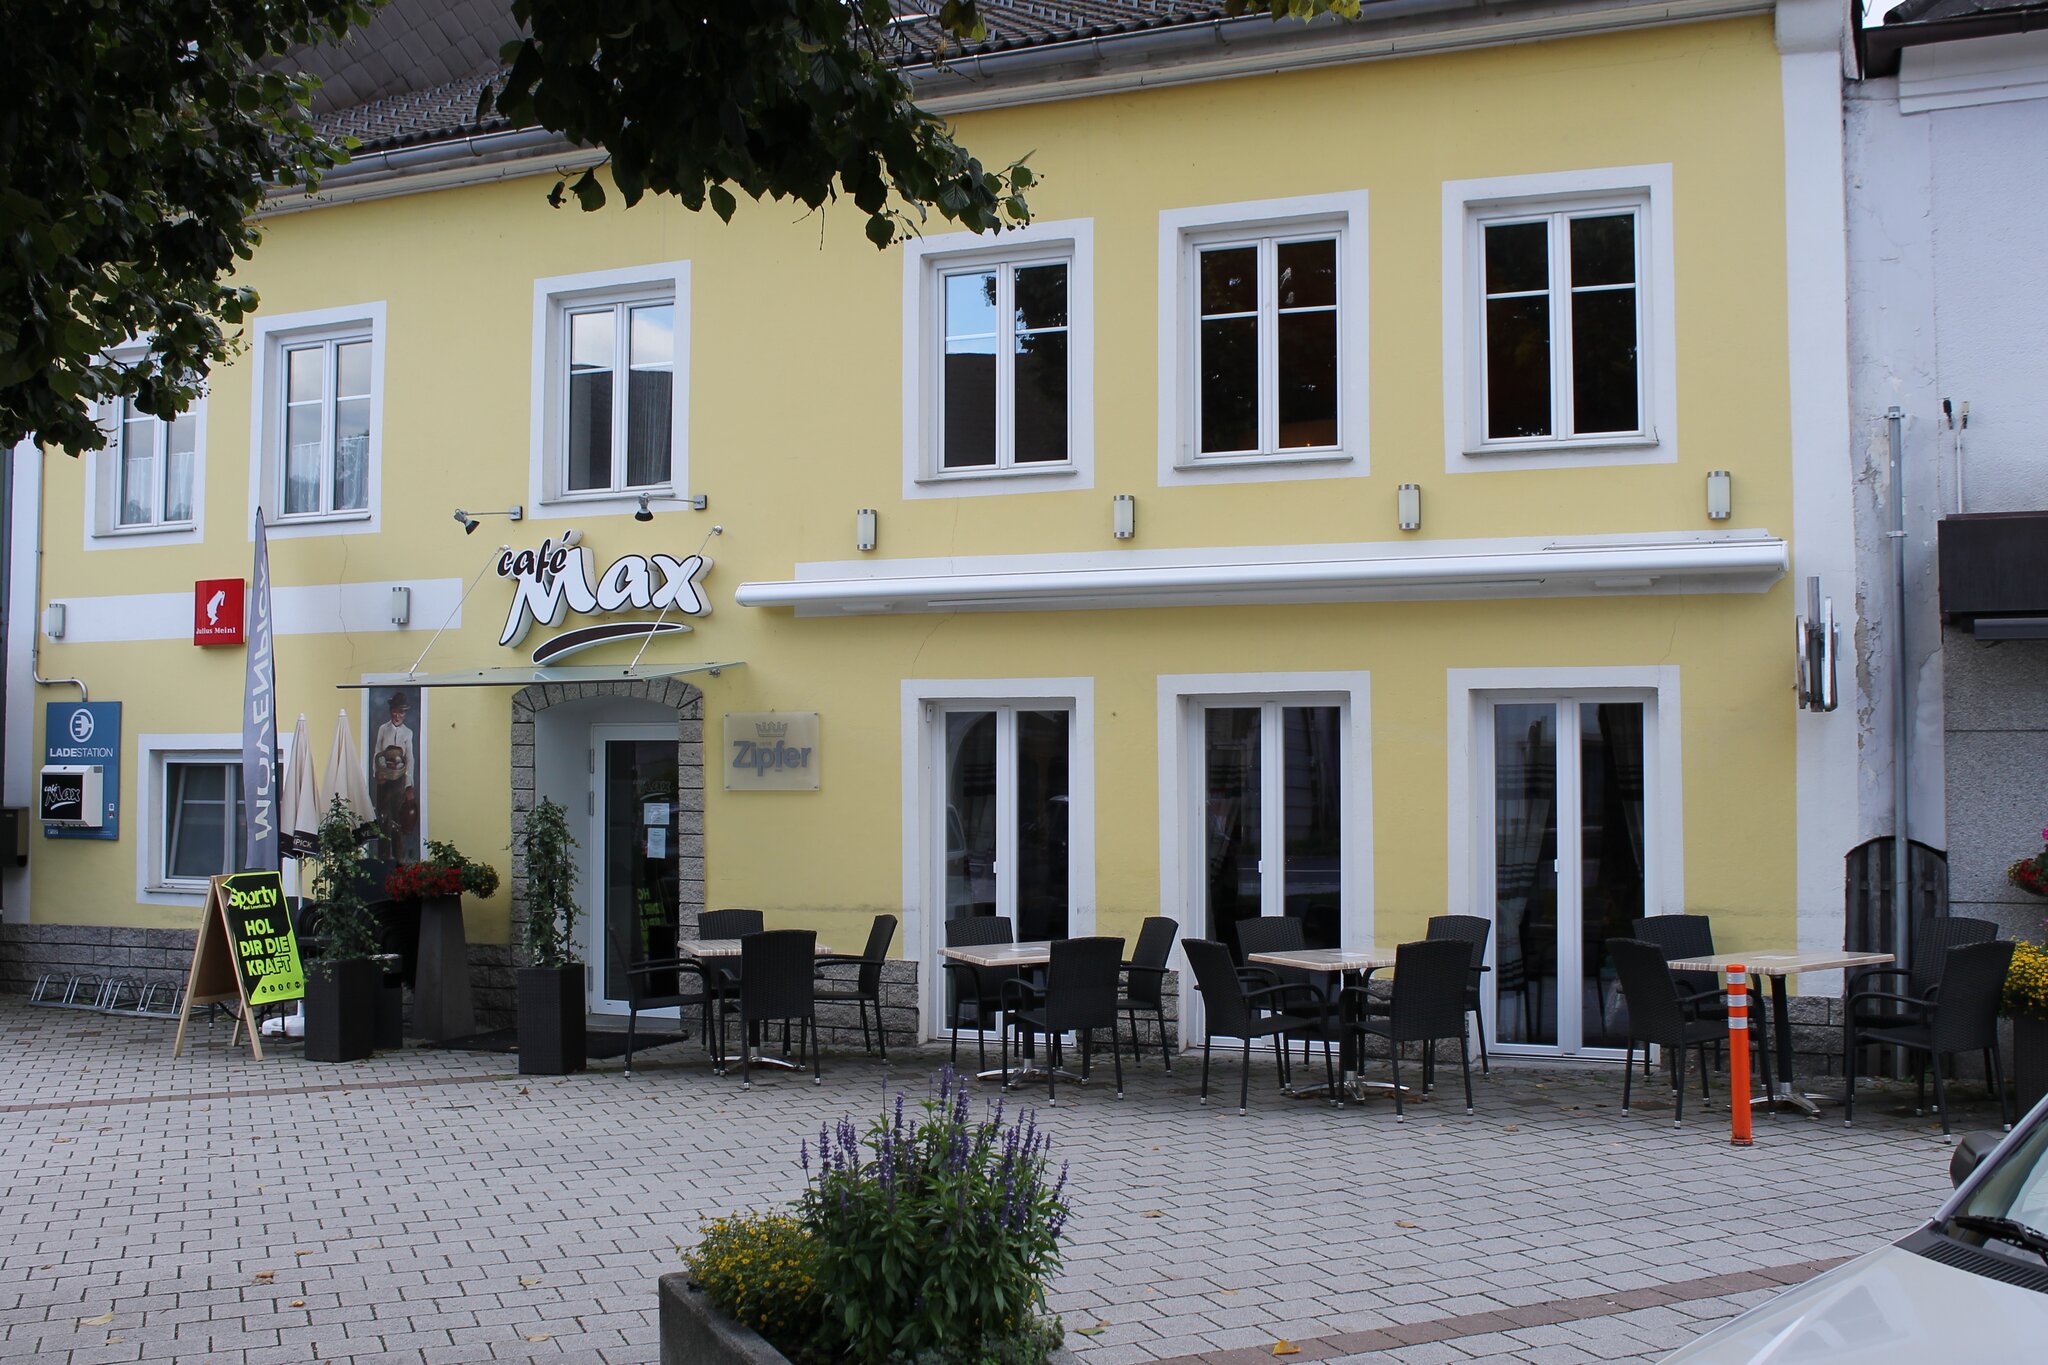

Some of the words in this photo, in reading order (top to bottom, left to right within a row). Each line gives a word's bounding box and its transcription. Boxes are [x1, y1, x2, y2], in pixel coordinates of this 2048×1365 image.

[497, 529, 573, 583] café
[498, 546, 705, 646] Max
[196, 627, 213, 635] Julius
[214, 626, 236, 634] Meinl
[49, 747, 114, 758] LADESTATION
[732, 740, 812, 777] Zipfer
[44, 783, 58, 794] café
[45, 785, 81, 807] Max
[230, 886, 277, 910] Sporty
[244, 918, 275, 937] HOL
[239, 940, 264, 957] DIR
[264, 935, 291, 955] DIE
[246, 955, 291, 977] KRAFT
